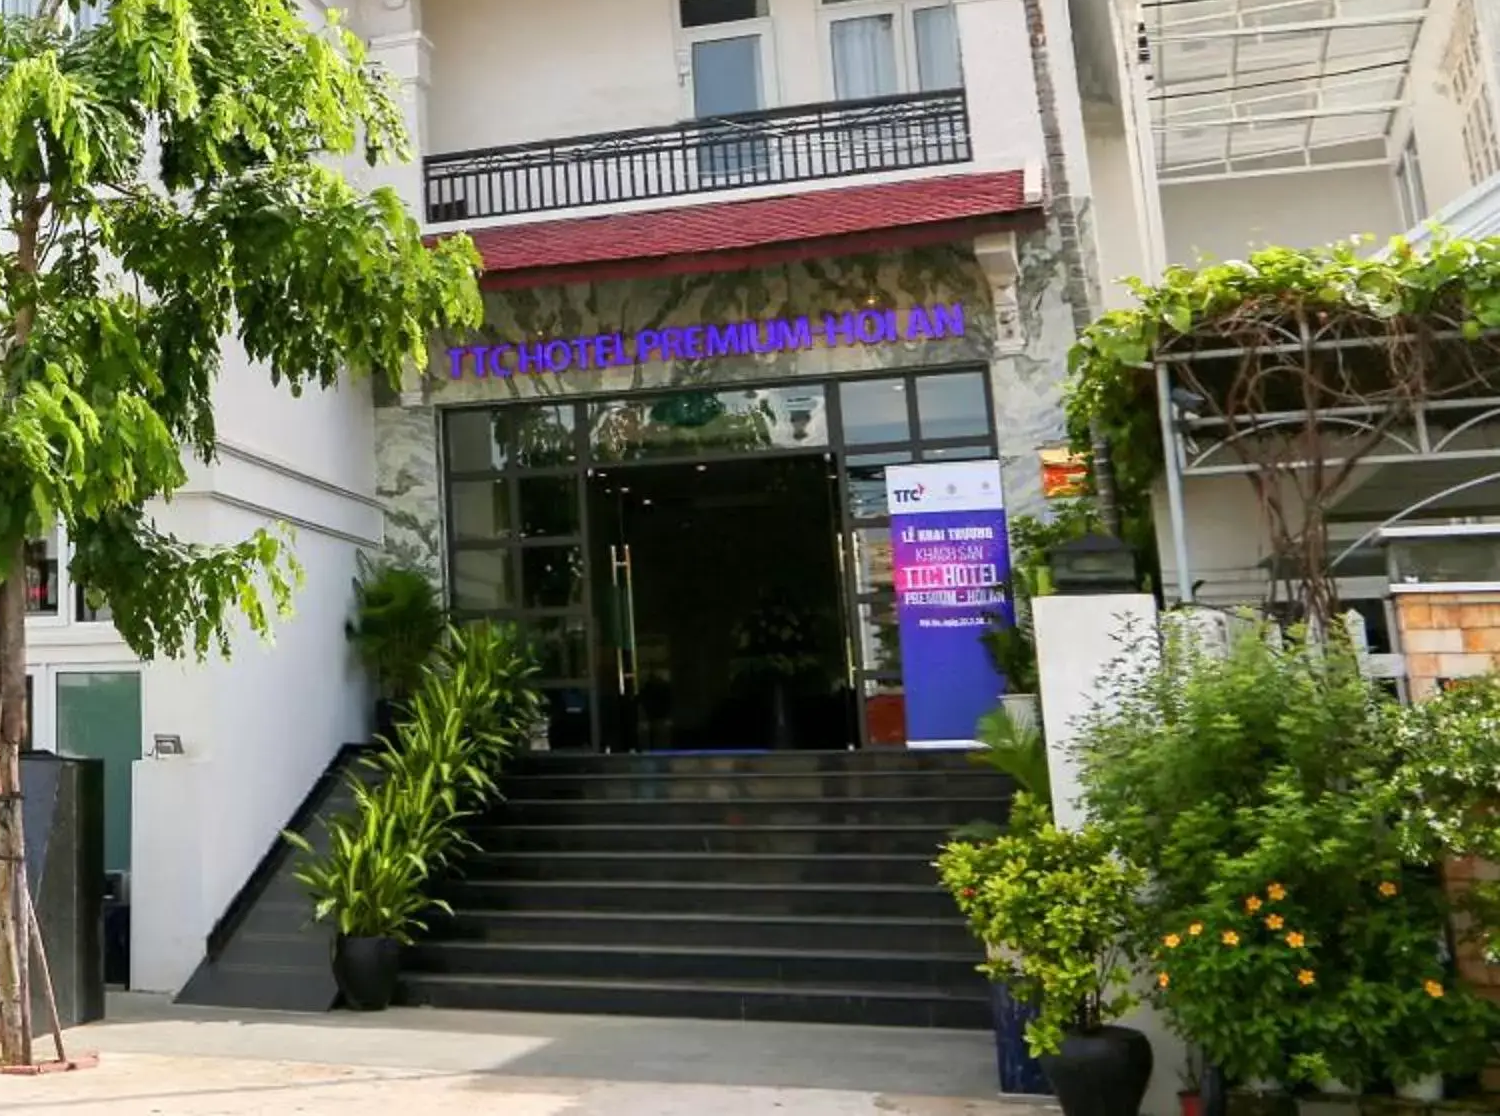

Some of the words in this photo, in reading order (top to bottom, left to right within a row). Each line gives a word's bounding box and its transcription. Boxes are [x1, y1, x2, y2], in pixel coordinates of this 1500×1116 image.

[448, 344, 512, 379] TTC
[517, 330, 631, 373] HOTEL
[906, 303, 965, 340] AN
[894, 489, 921, 503] TTC
